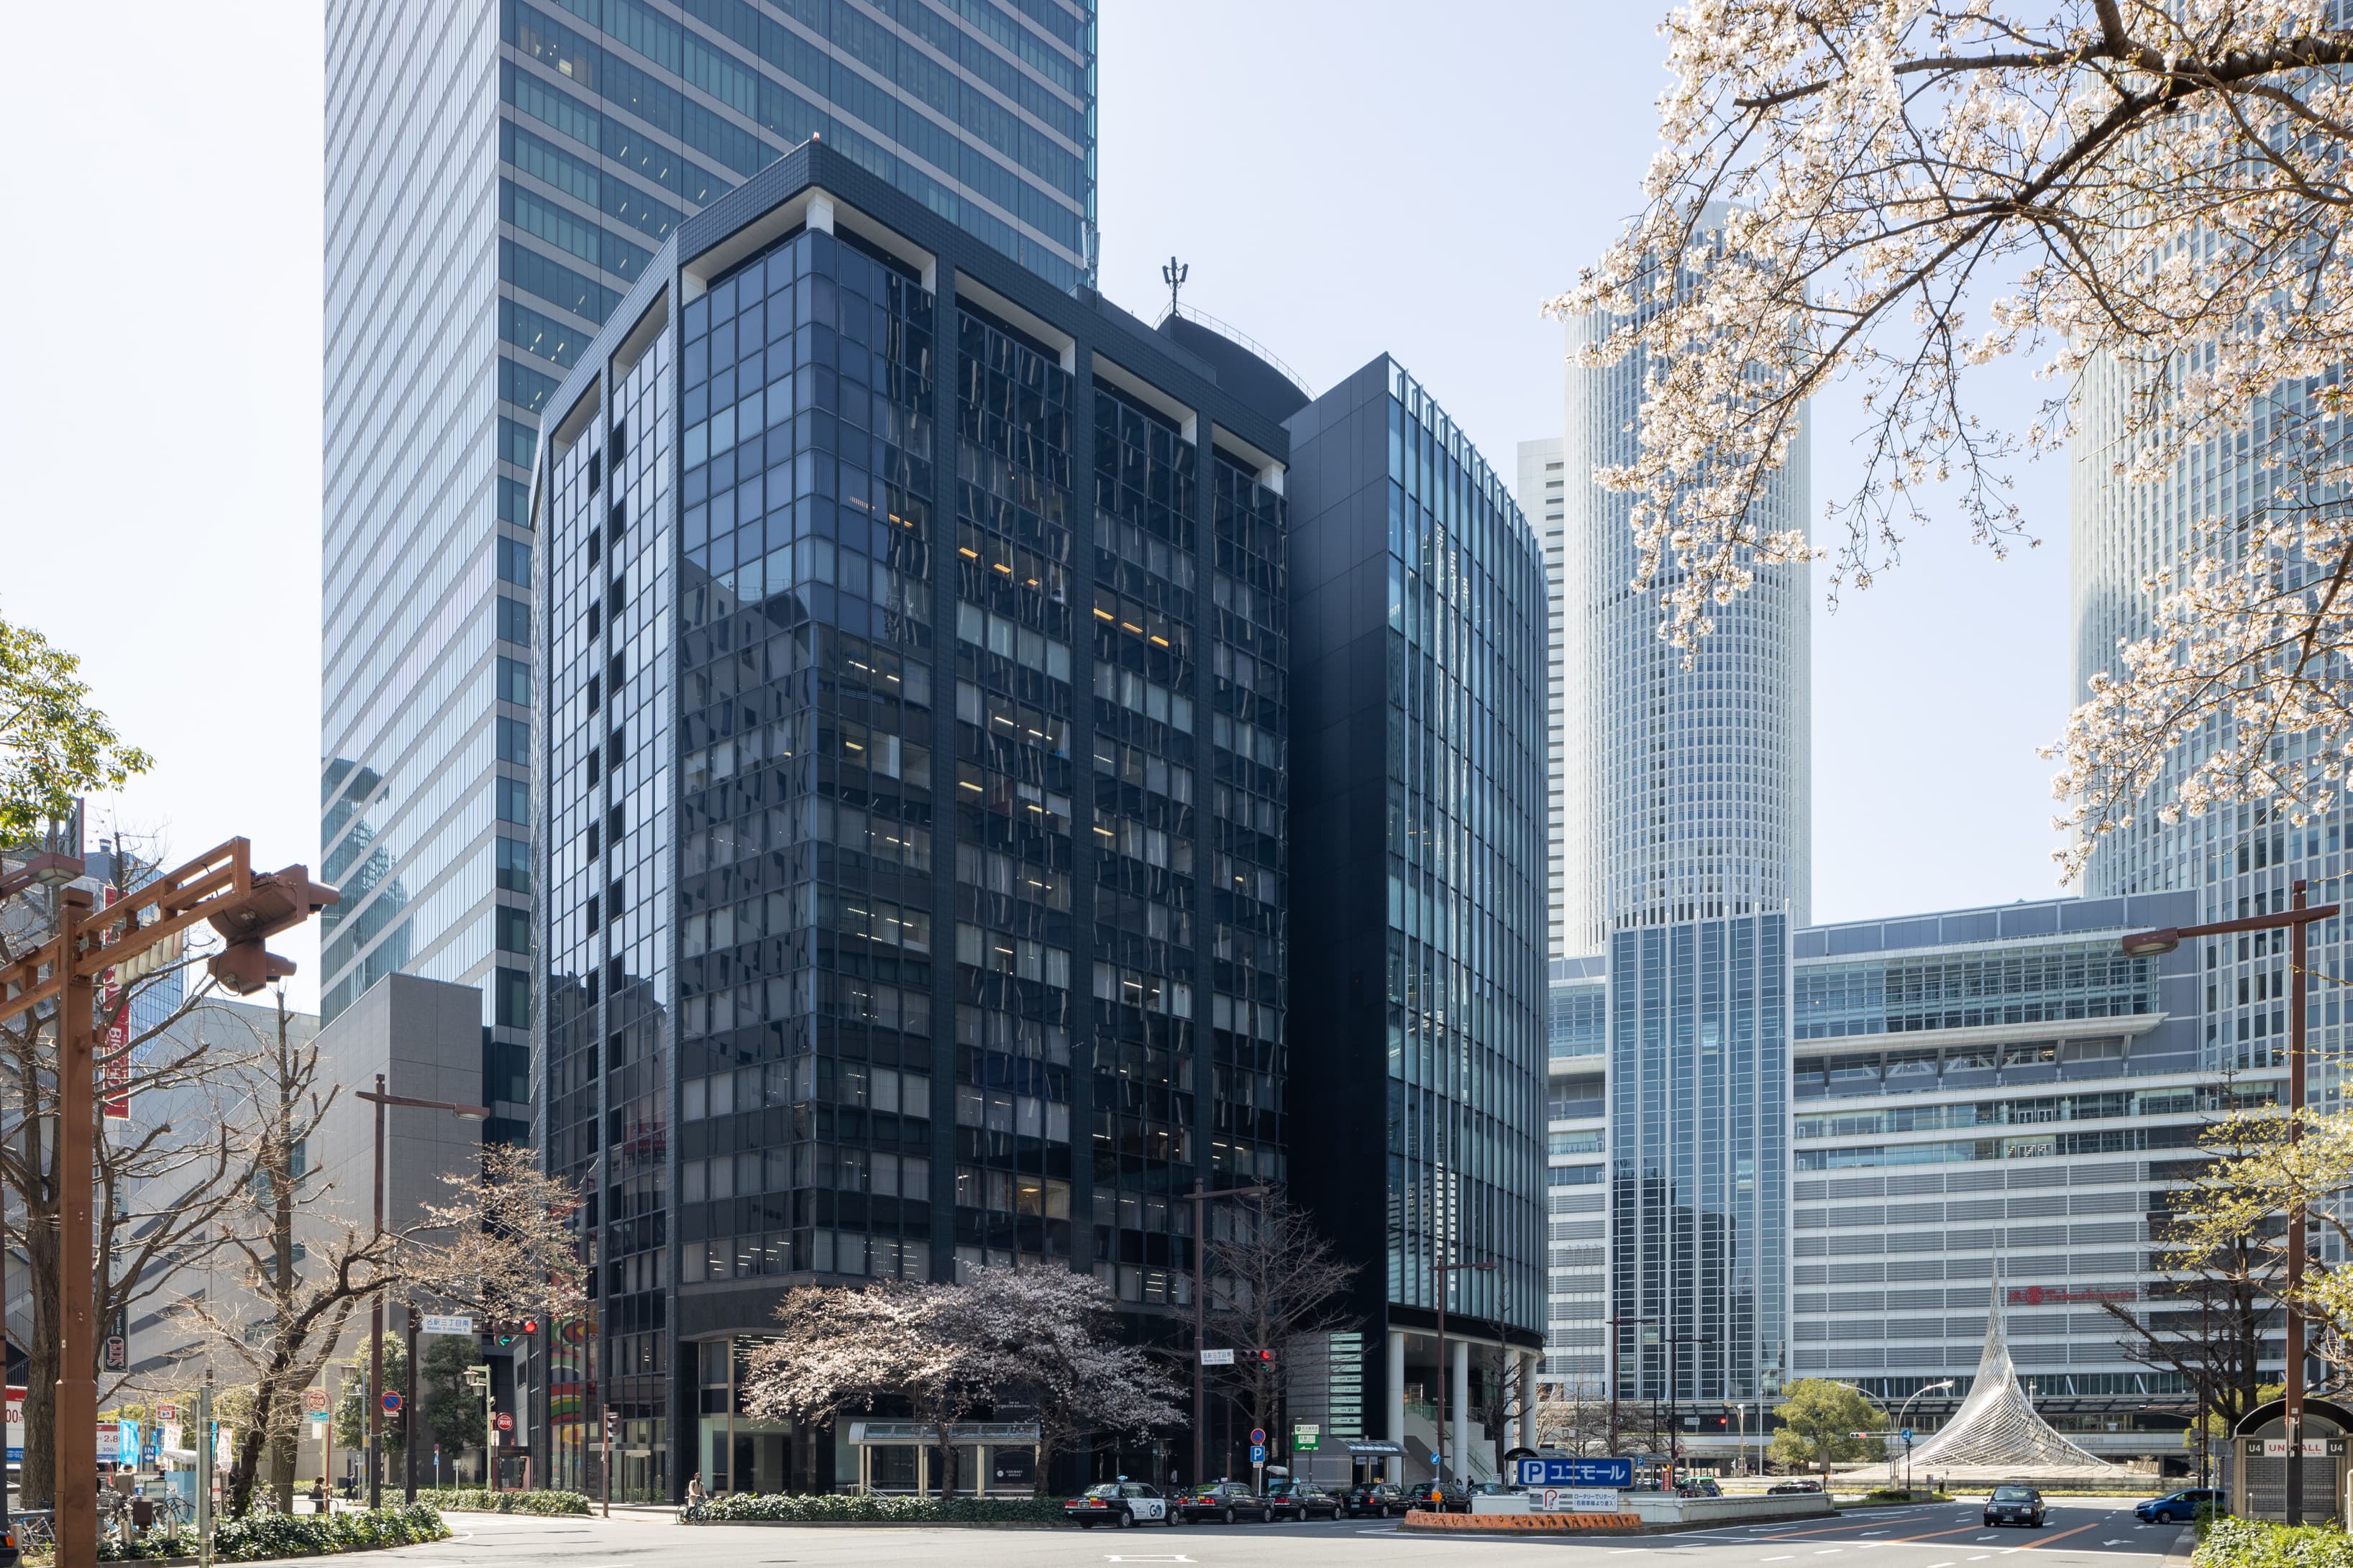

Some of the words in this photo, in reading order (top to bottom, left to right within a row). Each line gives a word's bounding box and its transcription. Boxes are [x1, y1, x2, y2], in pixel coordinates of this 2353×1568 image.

[1254, 1447, 1262, 1460] P
[2330, 1444, 2343, 1452] U4
[1528, 1463, 1543, 1482] P
[1550, 1465, 1626, 1480] ユニモール
